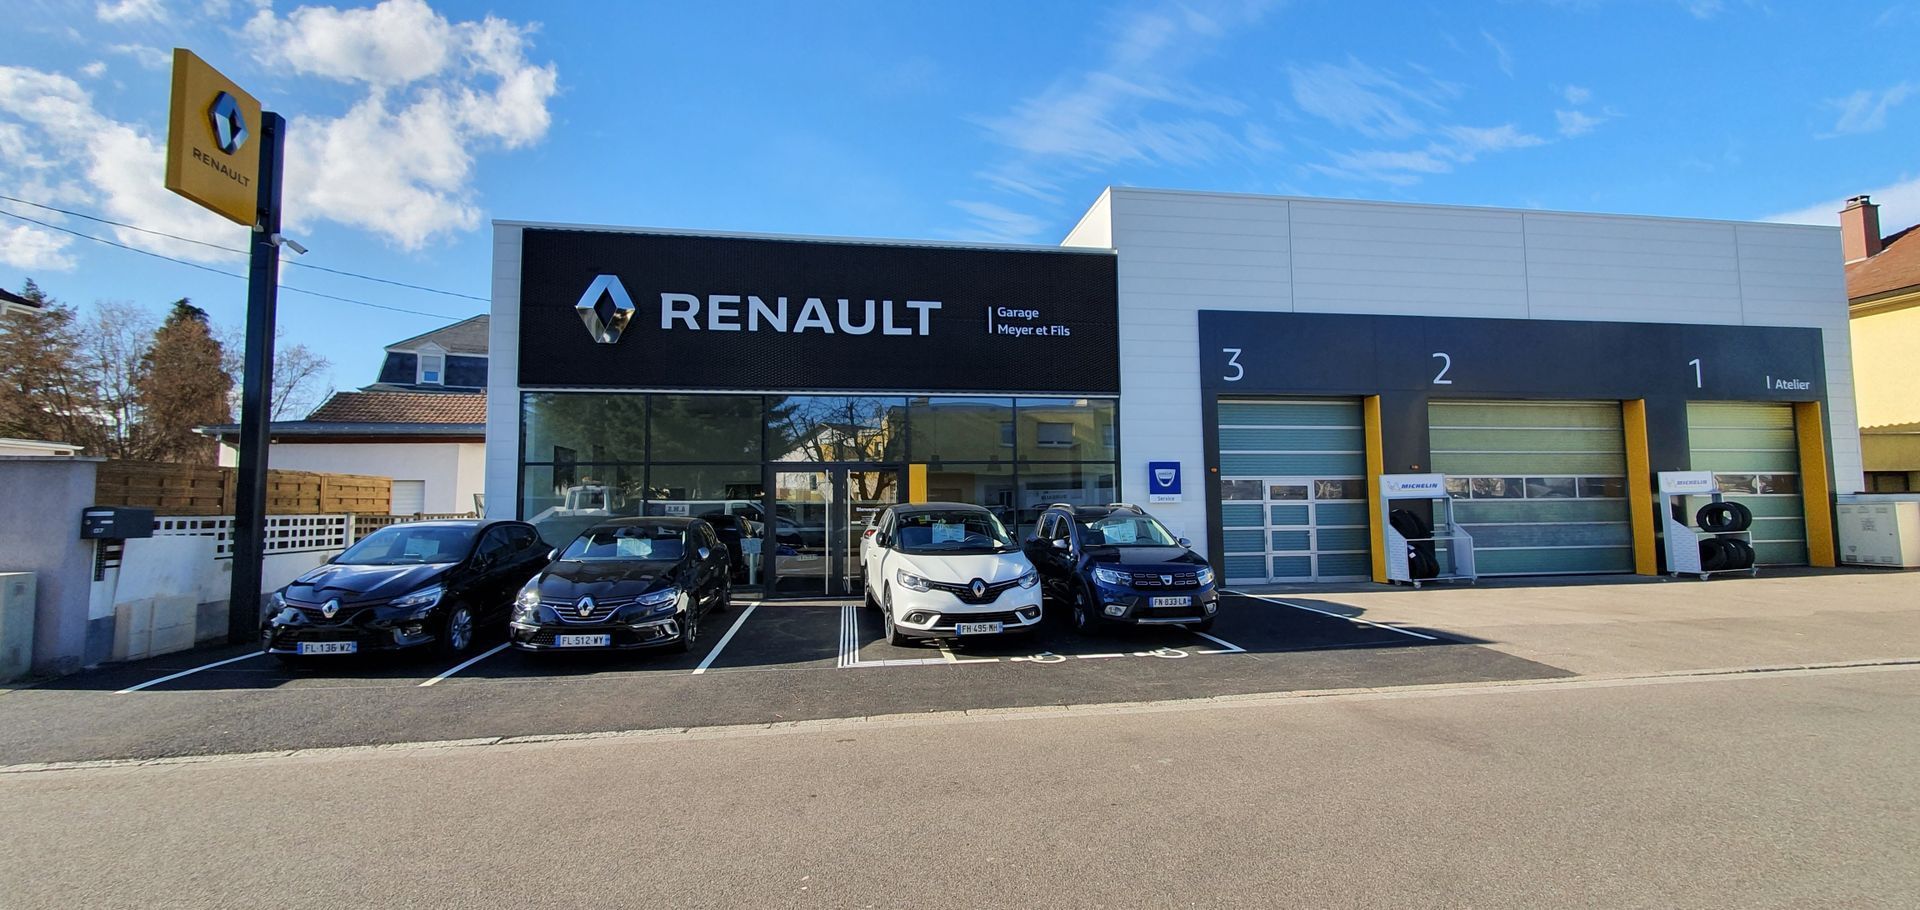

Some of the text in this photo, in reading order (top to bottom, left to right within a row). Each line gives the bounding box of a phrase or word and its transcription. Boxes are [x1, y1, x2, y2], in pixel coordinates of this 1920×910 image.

[193, 146, 250, 187] RENAULT
[660, 292, 942, 336] RENAULT
[997, 306, 1039, 320] Garage
[997, 324, 1071, 337] Meyer et Fils
[1222, 348, 1244, 382] 3
[1432, 352, 1453, 385] 2
[1688, 358, 1702, 389] 1
[1775, 379, 1810, 391] Atelier
